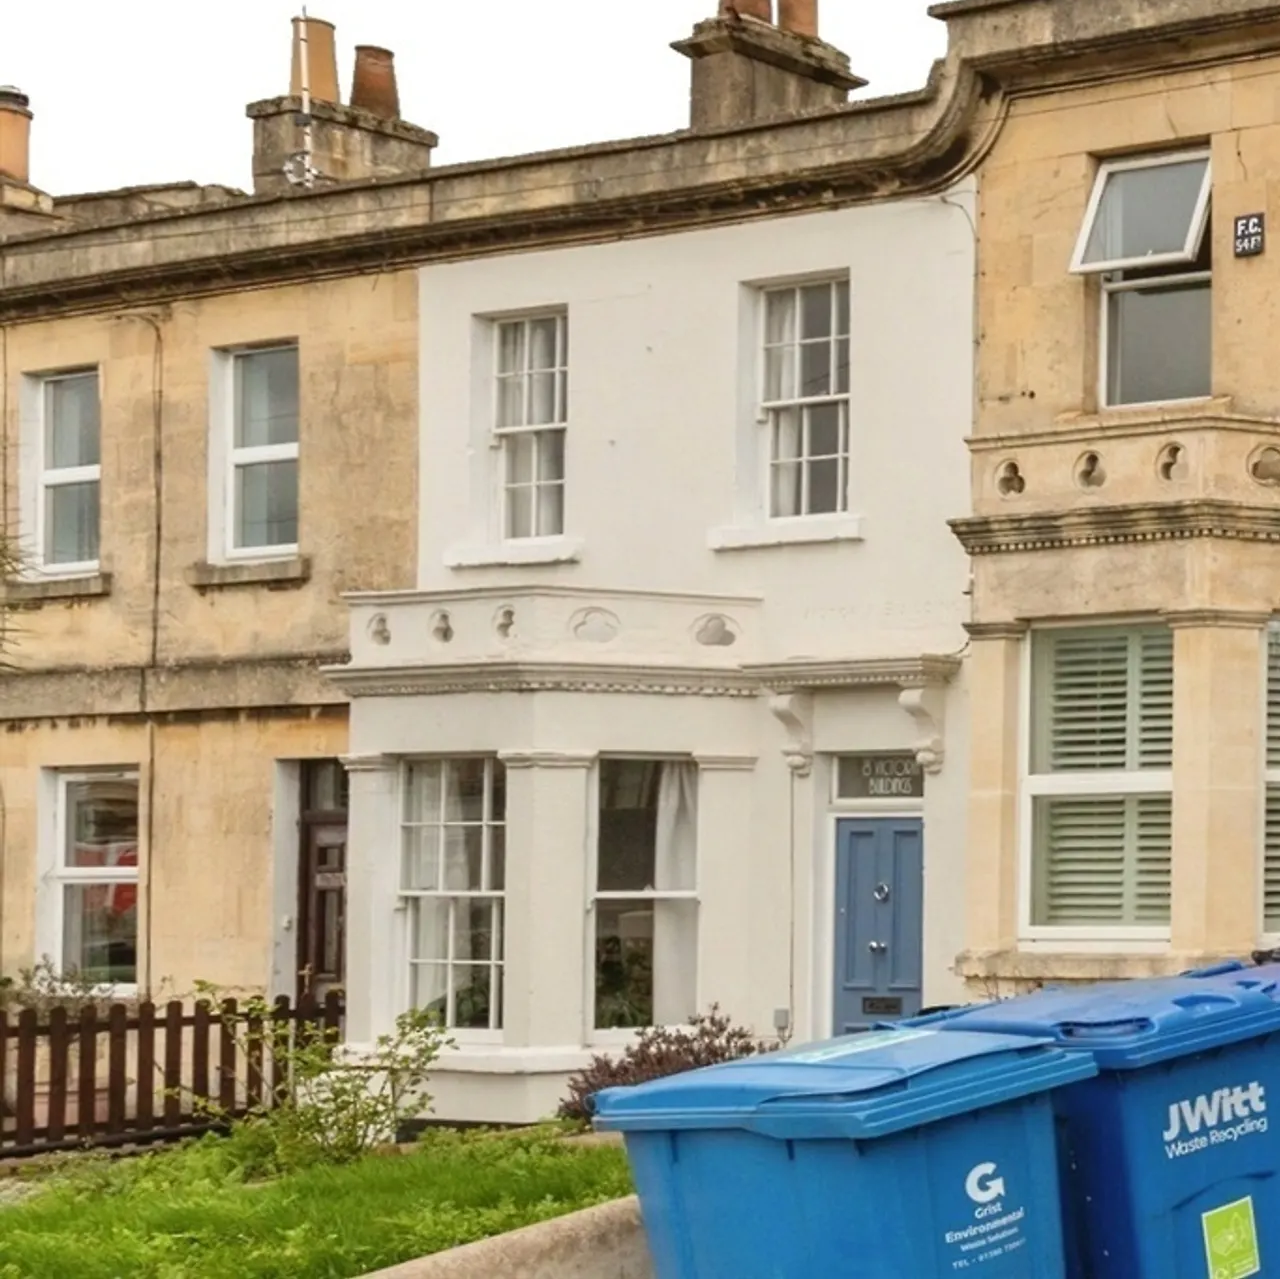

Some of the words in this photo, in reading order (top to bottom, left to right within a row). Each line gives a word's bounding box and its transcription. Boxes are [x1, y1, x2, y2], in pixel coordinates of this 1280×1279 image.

[1237, 217, 1262, 235] F.C.
[1162, 1080, 1267, 1142] JWitt
[1164, 1136, 1209, 1159] Waste
[1209, 1116, 1269, 1145] Recycling
[965, 1161, 1005, 1204] G
[945, 1206, 1025, 1244] Environmental
[974, 1201, 1003, 1219] Grist
